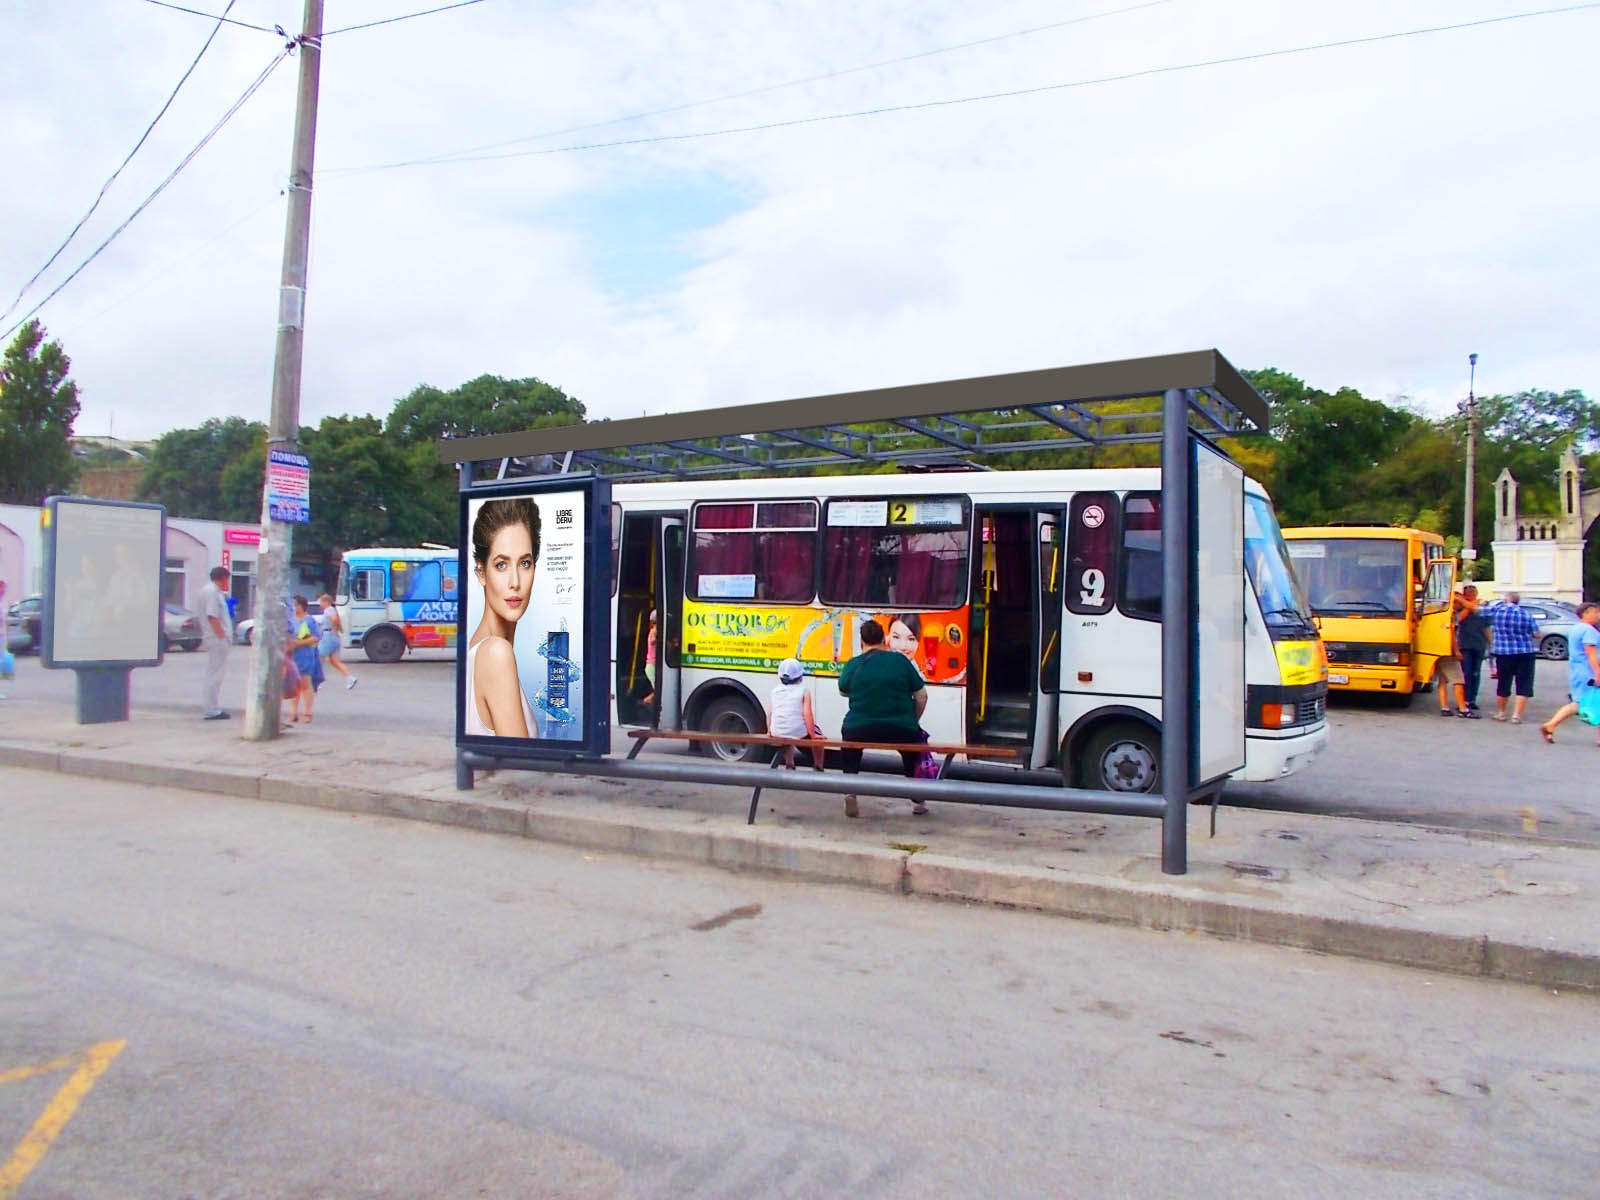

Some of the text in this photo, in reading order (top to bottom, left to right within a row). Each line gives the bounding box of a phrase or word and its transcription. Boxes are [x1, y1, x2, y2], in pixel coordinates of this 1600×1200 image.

[271, 451, 309, 466] ПОМОЩЬ
[556, 509, 573, 517] LIBRE
[895, 504, 907, 522] 2
[1081, 569, 1104, 606] 9
